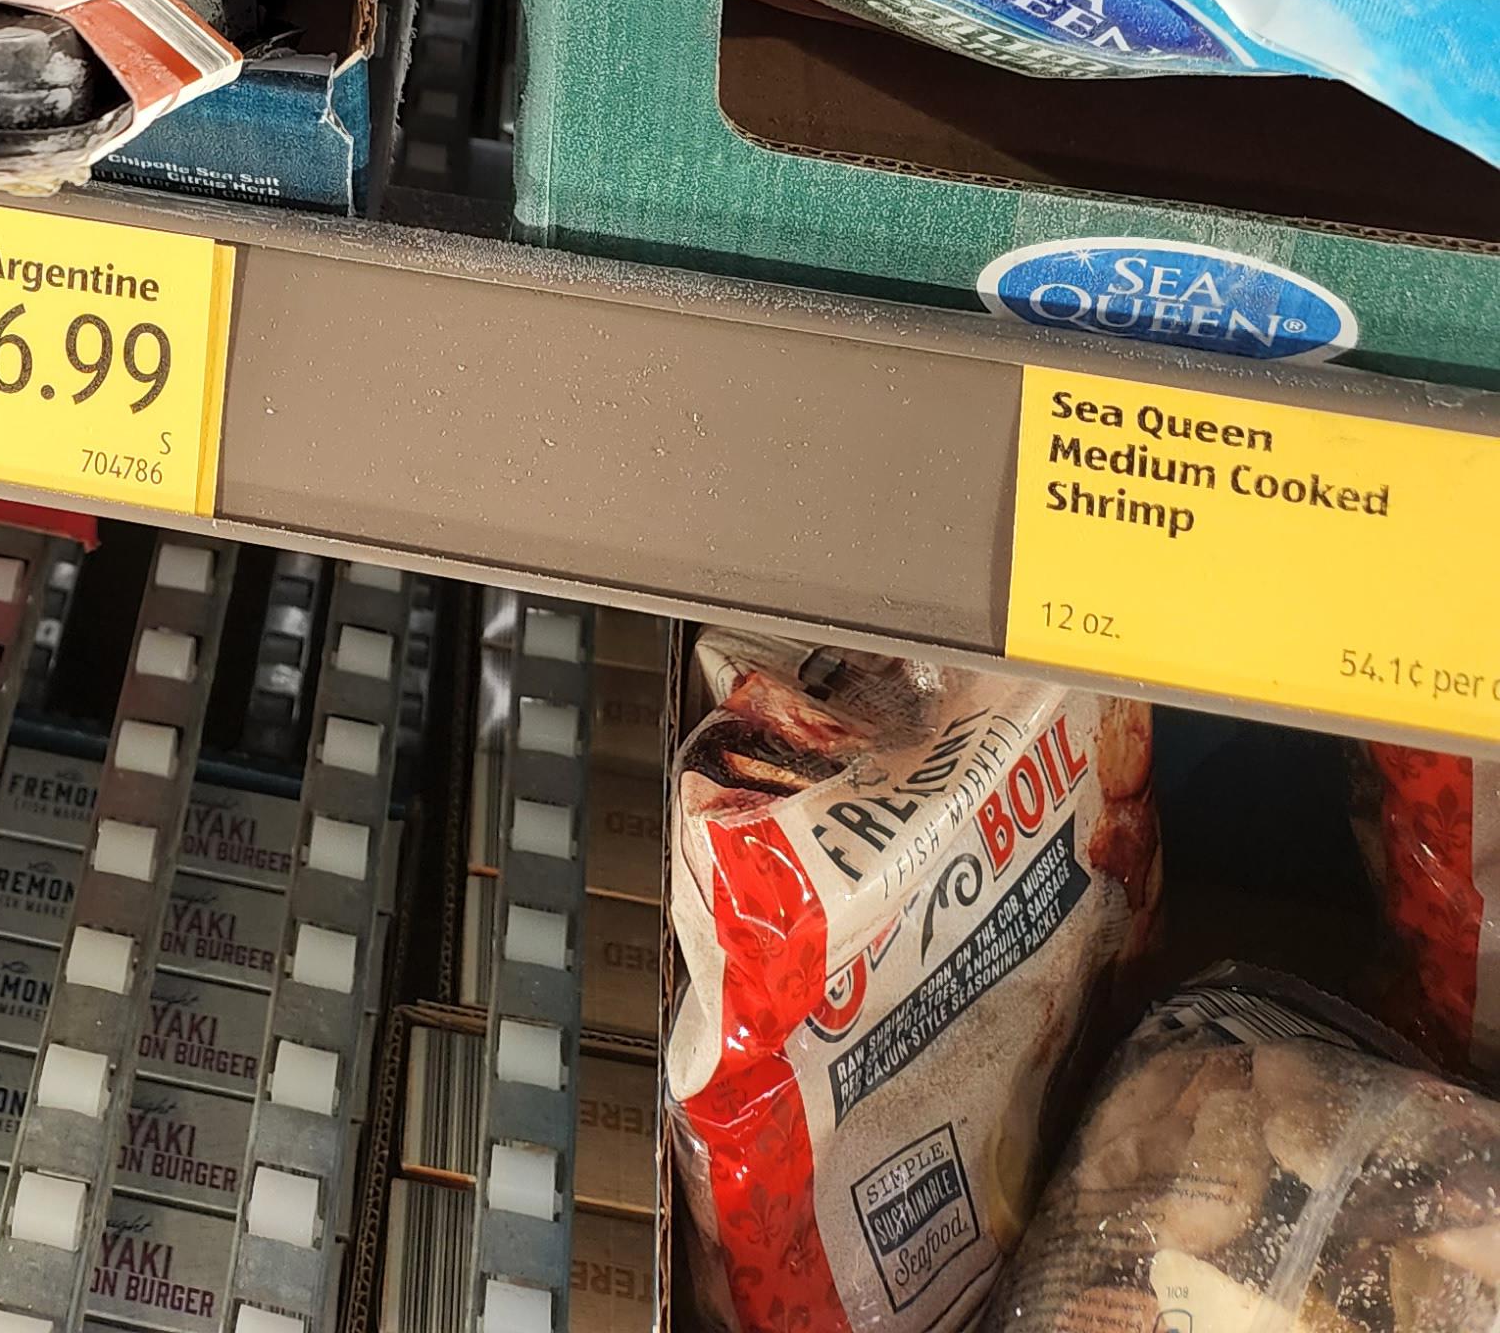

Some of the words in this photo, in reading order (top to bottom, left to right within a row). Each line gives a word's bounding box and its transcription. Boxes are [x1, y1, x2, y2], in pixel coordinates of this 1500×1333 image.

[107, 154, 190, 175] Chipotle
[195, 166, 234, 181] Sea
[239, 172, 281, 187] Salt
[167, 171, 227, 190] Citrus
[232, 182, 282, 197] Herb
[1106, 256, 1225, 307] SEA
[1029, 282, 1282, 349] QUEEN
[159, 431, 172, 455] S
[1050, 390, 1123, 429] Sea
[1136, 404, 1274, 453] Queen
[81, 448, 164, 485] 704786
[1048, 434, 1216, 490] Medium
[1230, 464, 1390, 518] Cooked
[1046, 481, 1196, 540] Shrimp
[1041, 601, 1074, 632] 12
[1081, 610, 1121, 640] oz.
[1339, 649, 1424, 691] 54.1¢
[1434, 665, 1484, 703] per
[975, 713, 1089, 883] BOIL
[211, 836, 293, 874] BURGER
[964, 917, 1027, 985] ANDOUILLE
[1026, 858, 1072, 923] SAUSAGE
[193, 933, 275, 974] BURGER
[836, 1041, 867, 1081] RAW
[919, 965, 953, 1005] CORN
[974, 927, 999, 954] THE
[865, 1004, 950, 1088] CAJUN-STYLE
[950, 946, 1022, 1016] SEASONING
[1022, 900, 1064, 957] PACKET
[173, 1041, 259, 1081] BURGER
[151, 1150, 239, 1194] BURGER
[124, 1280, 217, 1321] BURGER
